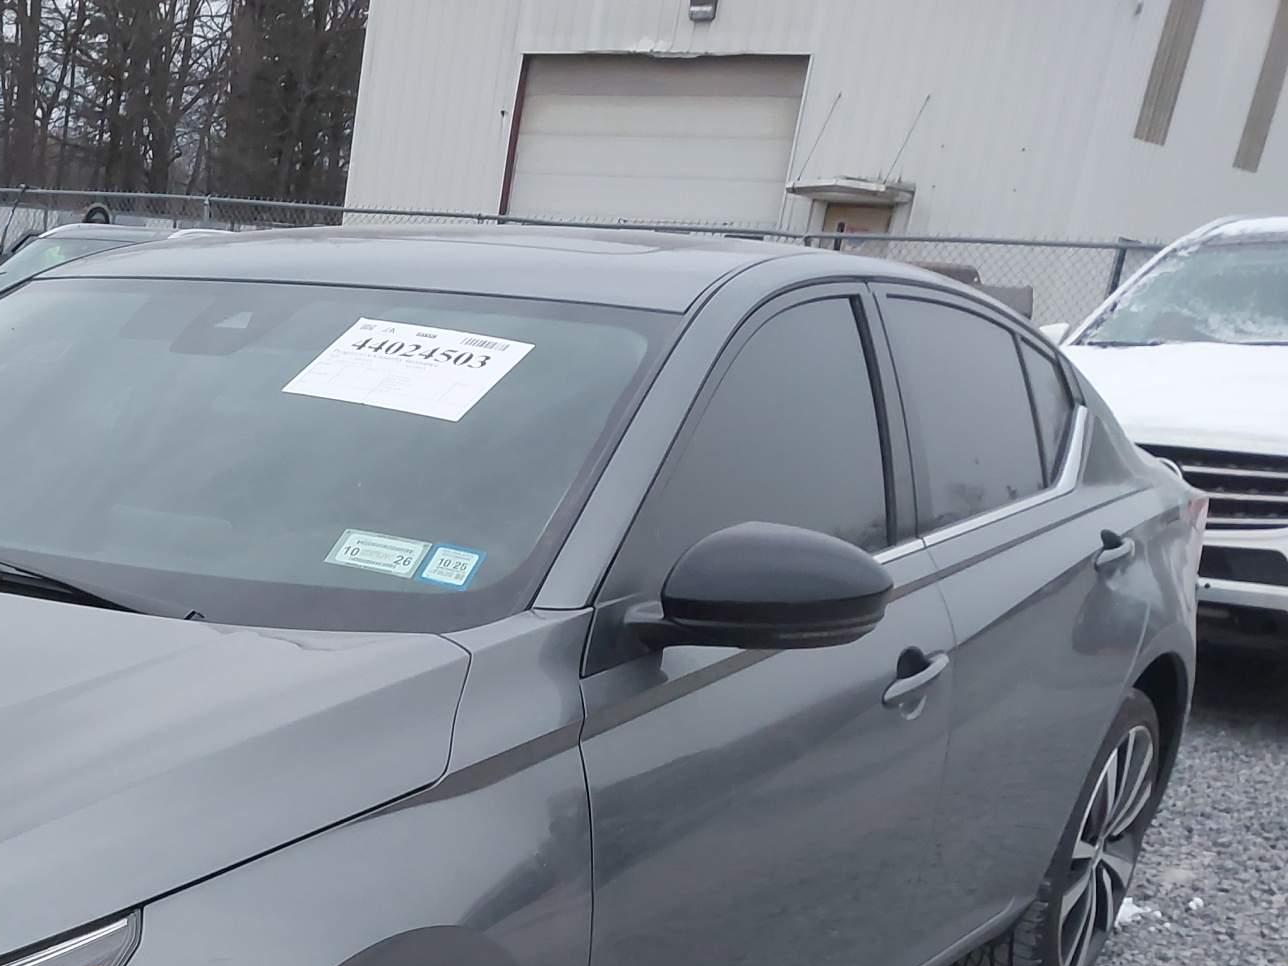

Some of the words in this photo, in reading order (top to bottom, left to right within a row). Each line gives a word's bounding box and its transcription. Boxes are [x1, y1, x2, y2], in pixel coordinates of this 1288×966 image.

[352, 337, 492, 369] 44024503
[342, 545, 360, 557] 10
[393, 554, 413, 567] 26
